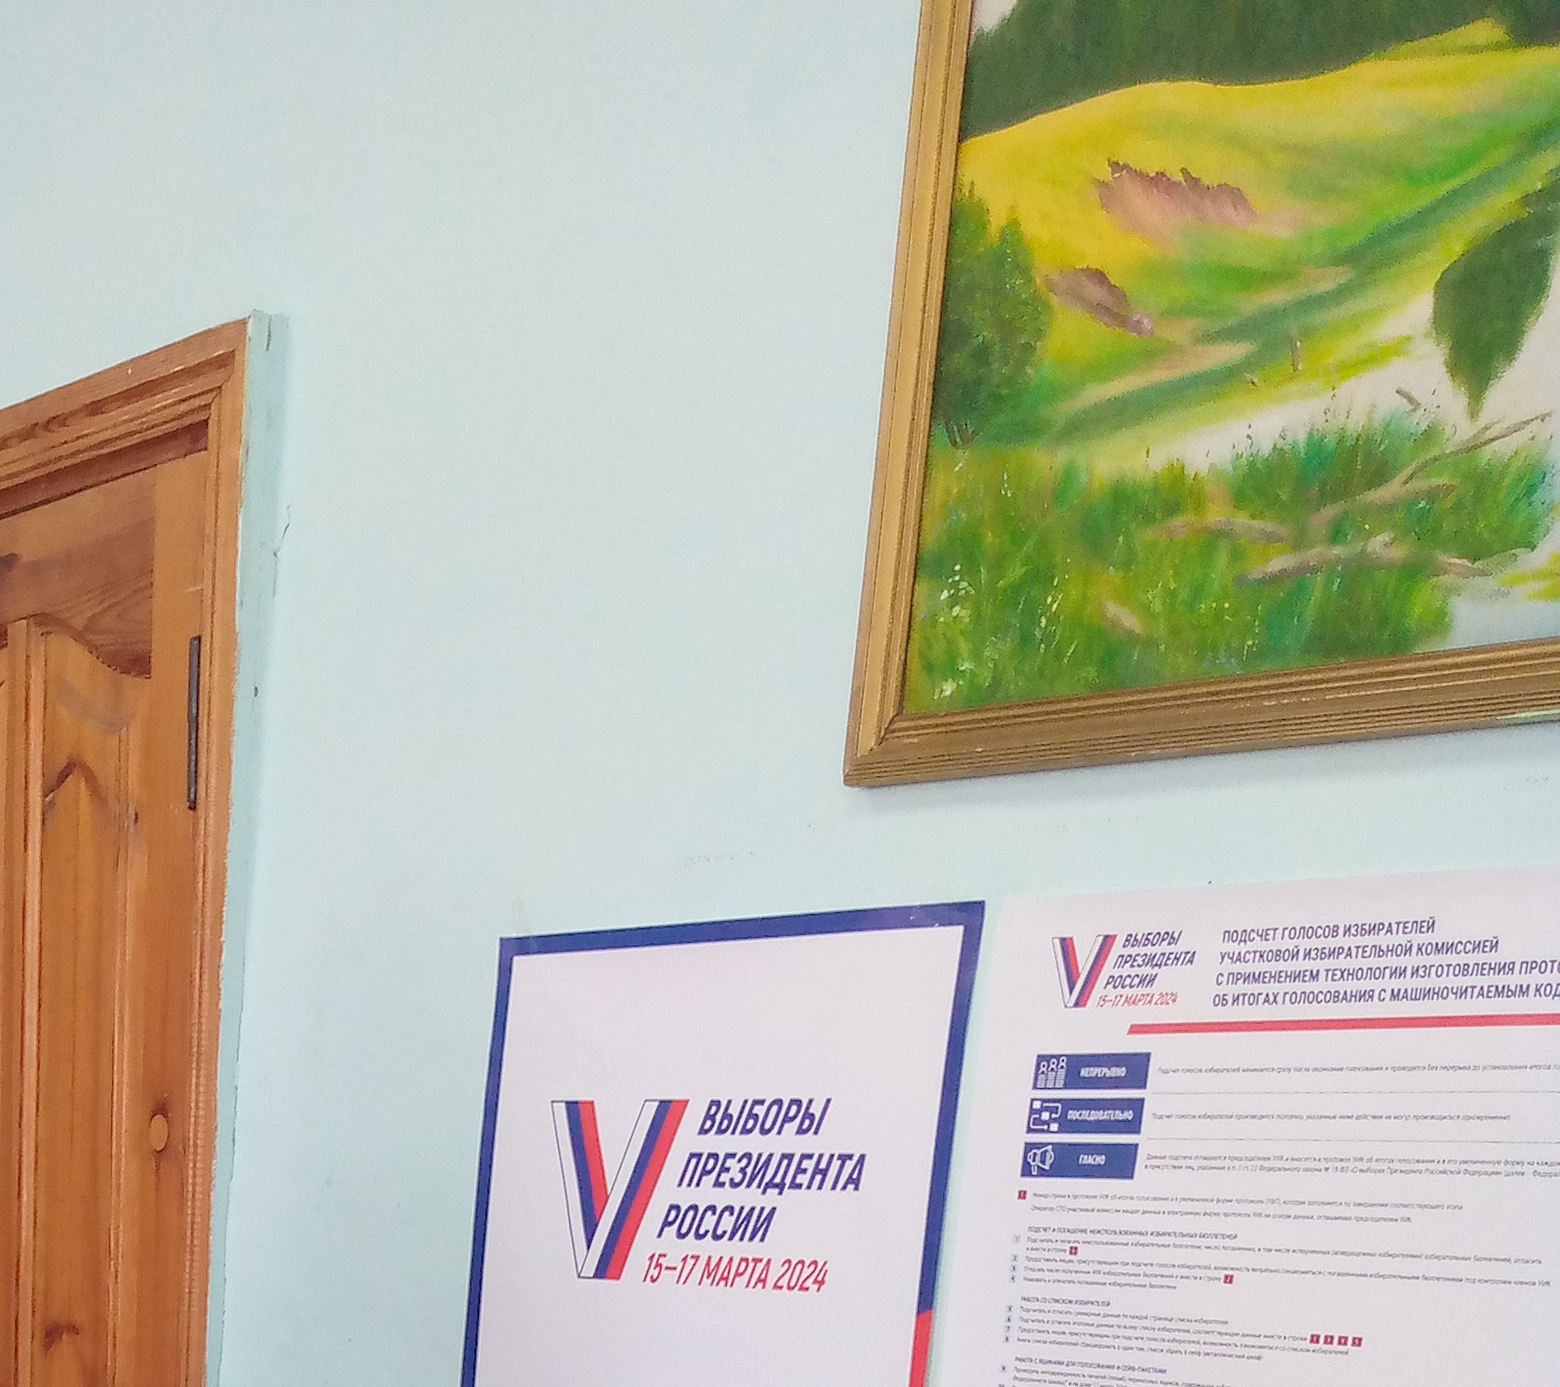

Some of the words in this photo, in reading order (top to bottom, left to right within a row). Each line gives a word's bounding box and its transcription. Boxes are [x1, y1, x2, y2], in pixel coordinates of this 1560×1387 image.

[1122, 930, 1183, 949] ВЫБОРЫ
[1222, 927, 1279, 946] ПОДСЧЕТ
[1281, 924, 1339, 942] ГОЛОСОВ
[1343, 916, 1435, 938] ИЗБИРАТЕЛЕЙ
[1113, 950, 1196, 970] ПРЕЗИДЕНТА
[1219, 945, 1300, 965] УЧАСТКОВОЙ
[1303, 939, 1413, 961] ИЗБИРАТЕЛЬНОЙ
[1416, 936, 1499, 957] КОМИССИЕЙ
[1103, 972, 1159, 990] РОССИИ
[1215, 972, 1224, 986] С
[1226, 968, 1320, 986] ПРИМЕНЕНИЕМ
[1323, 965, 1407, 983] ТЕХНОЛОГИИ
[1411, 961, 1515, 980] ИЗГОТОВЛЕНИЯ
[1124, 993, 1154, 1007] МАРТА
[1154, 992, 1178, 1006] 2024
[1212, 993, 1228, 1007] ОБ
[1231, 991, 1279, 1007] ИТОГАХ
[1282, 988, 1374, 1005] ГОЛОСОВАНИЯ
[1377, 987, 1386, 1002] С
[1389, 983, 1529, 1002] МАШИНОЧИТАЕМЫМ
[1079, 1066, 1127, 1079] НЕПРЕРЫВНО
[697, 1097, 833, 1136] ВЫБОРЫ
[1067, 1109, 1134, 1122] ПОСЛЕДОВАТЕЛЬНО
[1078, 1154, 1107, 1166] ГЛАСНО
[677, 1152, 866, 1196] ПРЕЗИДЕНТА
[657, 1203, 776, 1242] РОССИИ
[642, 1252, 699, 1285] 15–17
[700, 1257, 770, 1290] МАРТА
[772, 1260, 828, 1293] 2024
